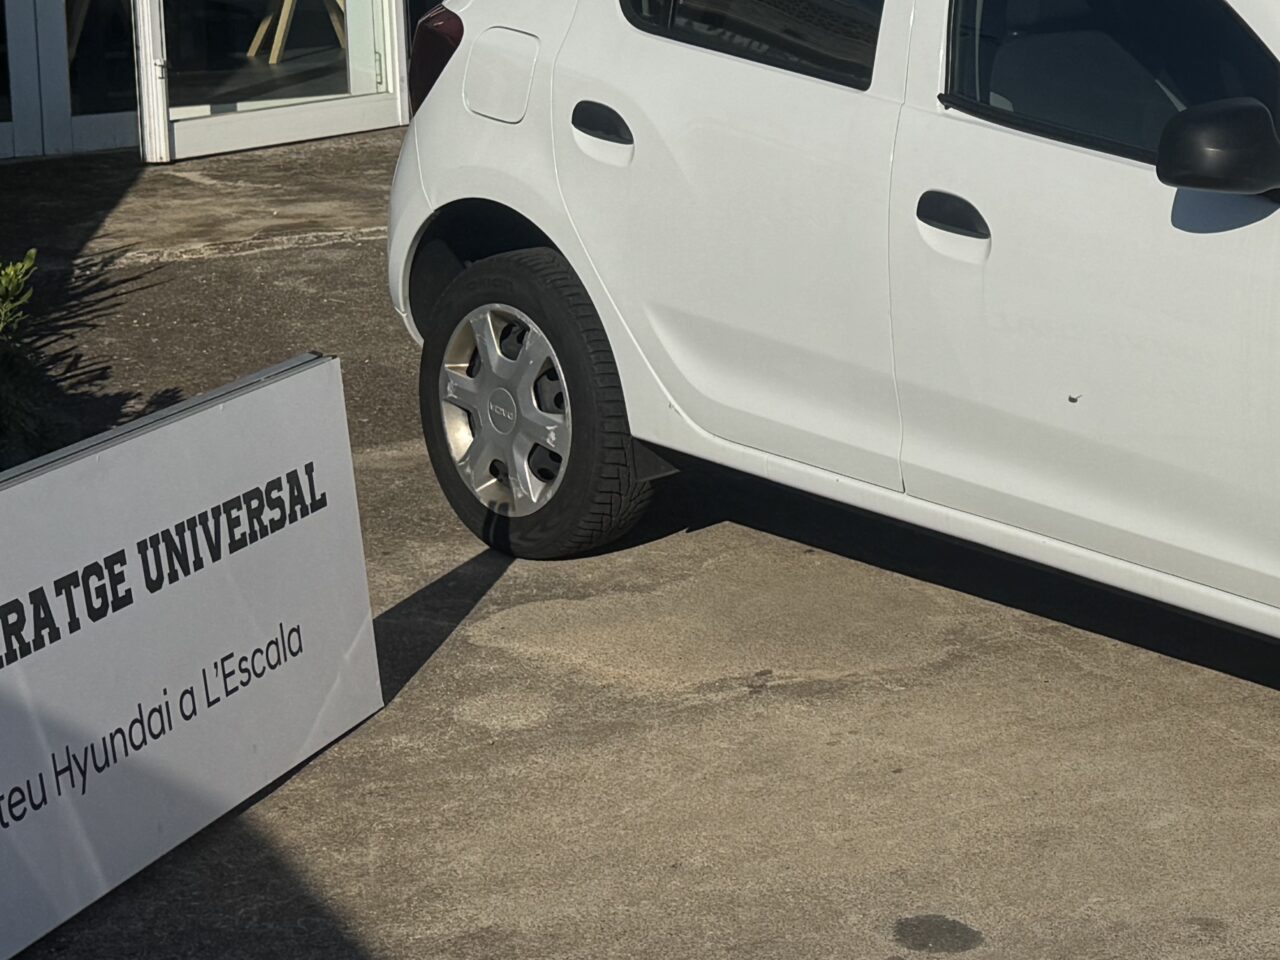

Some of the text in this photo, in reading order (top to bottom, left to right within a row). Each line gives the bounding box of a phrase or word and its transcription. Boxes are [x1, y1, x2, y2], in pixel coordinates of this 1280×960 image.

[0, 461, 327, 669] RATGE UNIVERSAL
[51, 688, 174, 795] Hyundai
[179, 686, 197, 721] a
[201, 621, 304, 708] L'Escala
